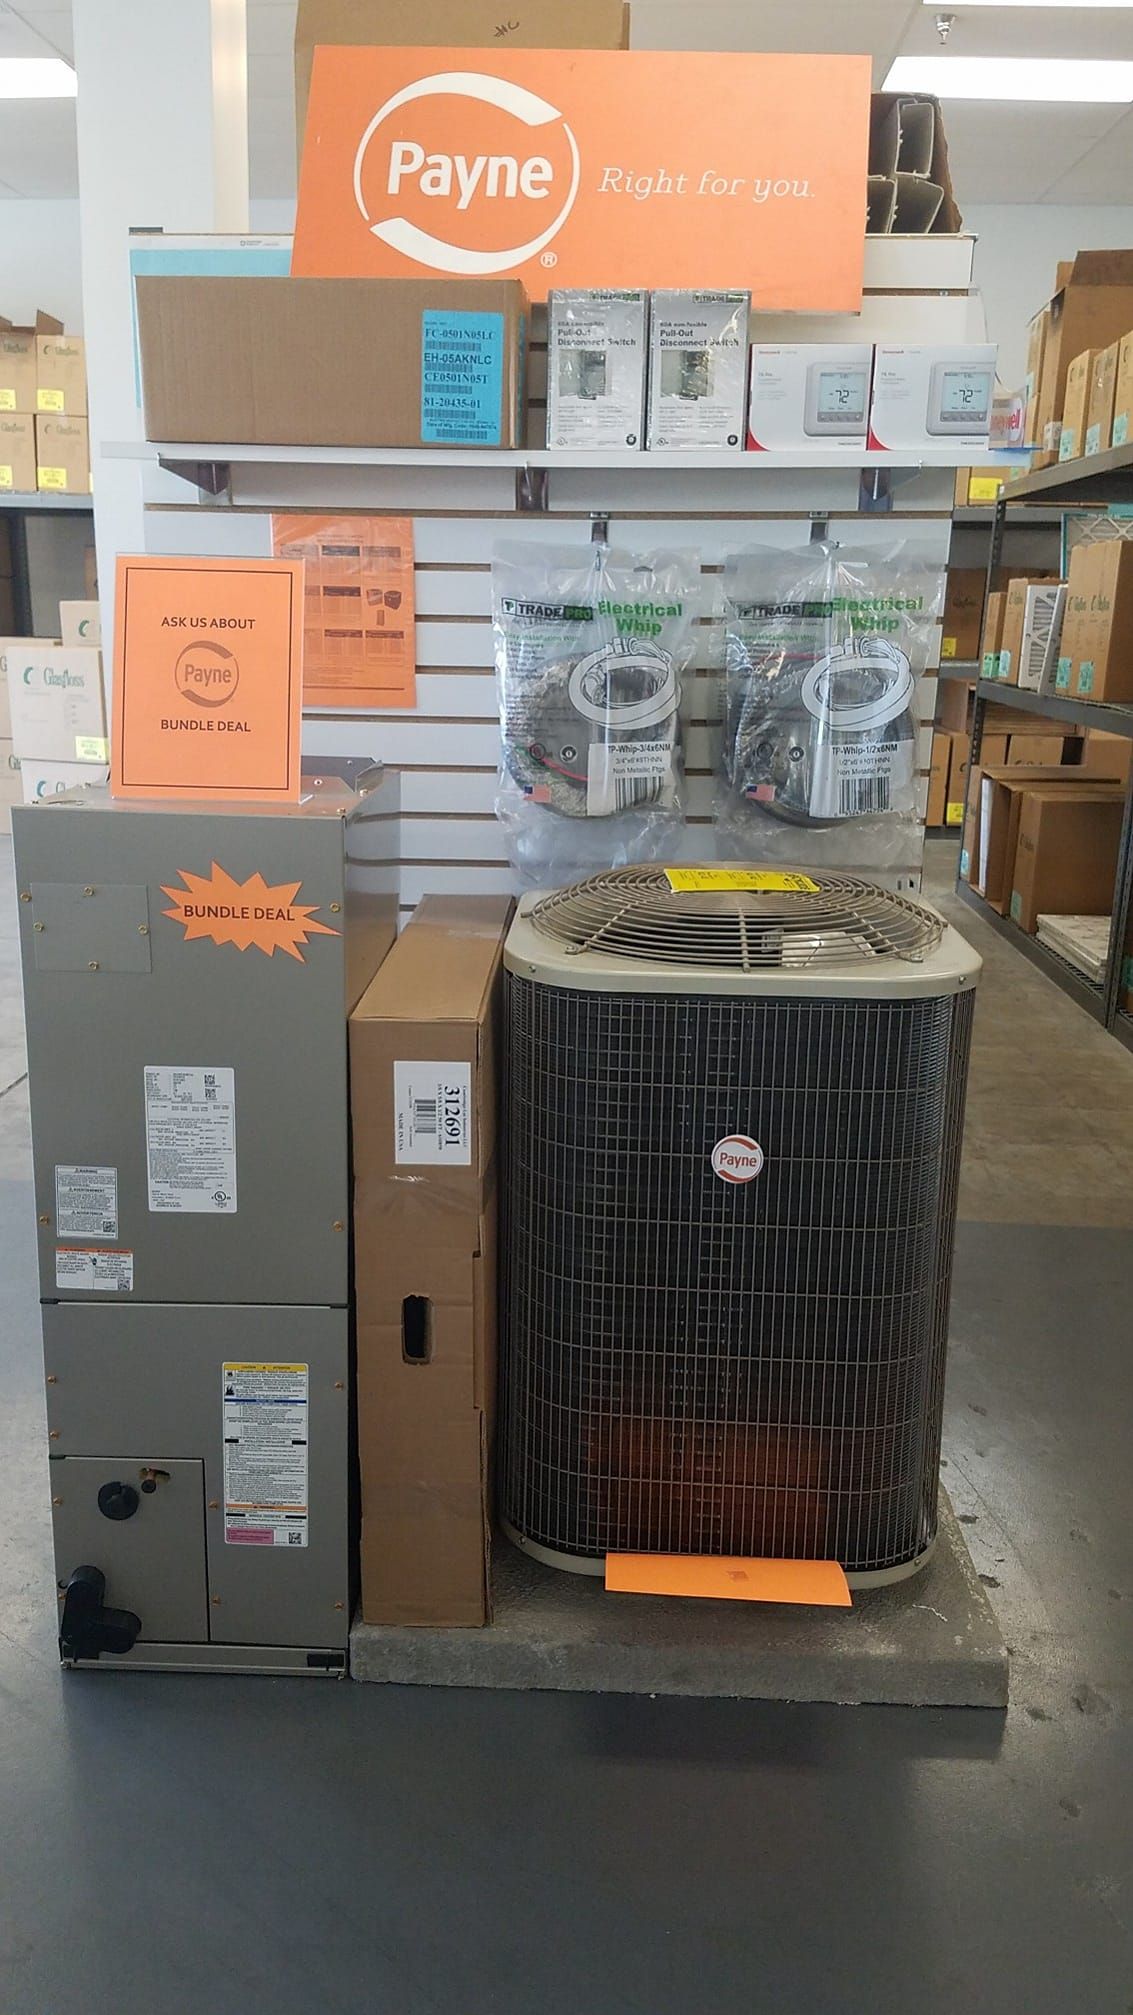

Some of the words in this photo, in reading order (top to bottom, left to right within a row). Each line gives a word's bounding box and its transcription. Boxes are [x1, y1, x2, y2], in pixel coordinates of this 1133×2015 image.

[387, 141, 554, 210] Payne
[598, 167, 688, 200] Right
[697, 170, 746, 197] for
[753, 177, 816, 204] you.
[424, 352, 492, 365] EH-05AKNLC
[424, 397, 481, 409] 81-20435-01
[835, 389, 850, 404] 72
[959, 389, 974, 404] 72
[597, 600, 682, 617] Electrical
[832, 597, 923, 612] Electrical
[161, 616, 187, 628] ASK
[190, 617, 207, 628] US
[210, 618, 256, 630] ABOUT
[616, 618, 663, 638] Whip
[184, 663, 232, 687] Payne
[160, 719, 214, 731] BUNDLE
[217, 721, 251, 732] DEAL
[608, 743, 671, 754] TP-Whip-3/4x6NM
[832, 743, 898, 756] TP-Whip-1/2x6NM
[184, 905, 250, 920] BUNDLE
[254, 908, 295, 921] DEAL
[444, 1085, 461, 1145] 312691
[719, 1152, 757, 1169] Payne
